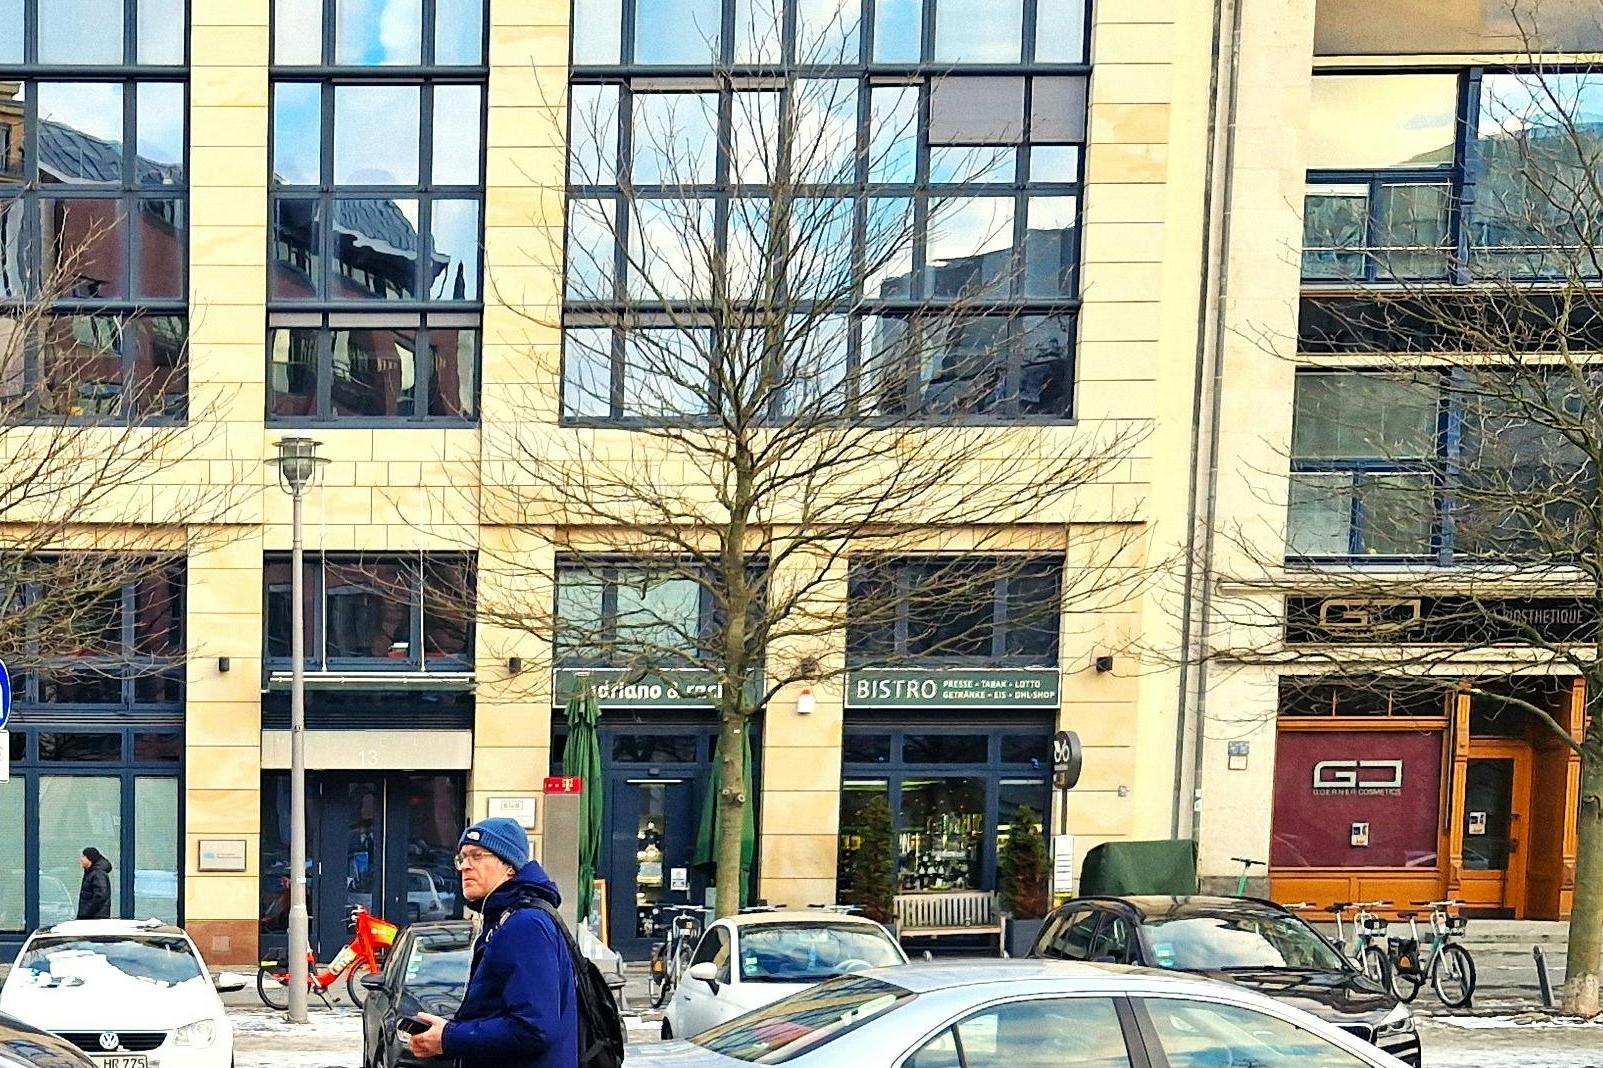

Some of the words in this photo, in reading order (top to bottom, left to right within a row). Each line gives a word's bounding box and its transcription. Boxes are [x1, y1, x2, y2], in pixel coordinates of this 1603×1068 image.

[590, 681, 662, 699] driano
[857, 679, 938, 699] BISTRO
[943, 680, 973, 688] PRESSE
[981, 680, 1007, 688] TABAK
[1015, 680, 1041, 688] LOTTO
[993, 691, 1007, 699] EIS
[359, 750, 379, 767] 13
